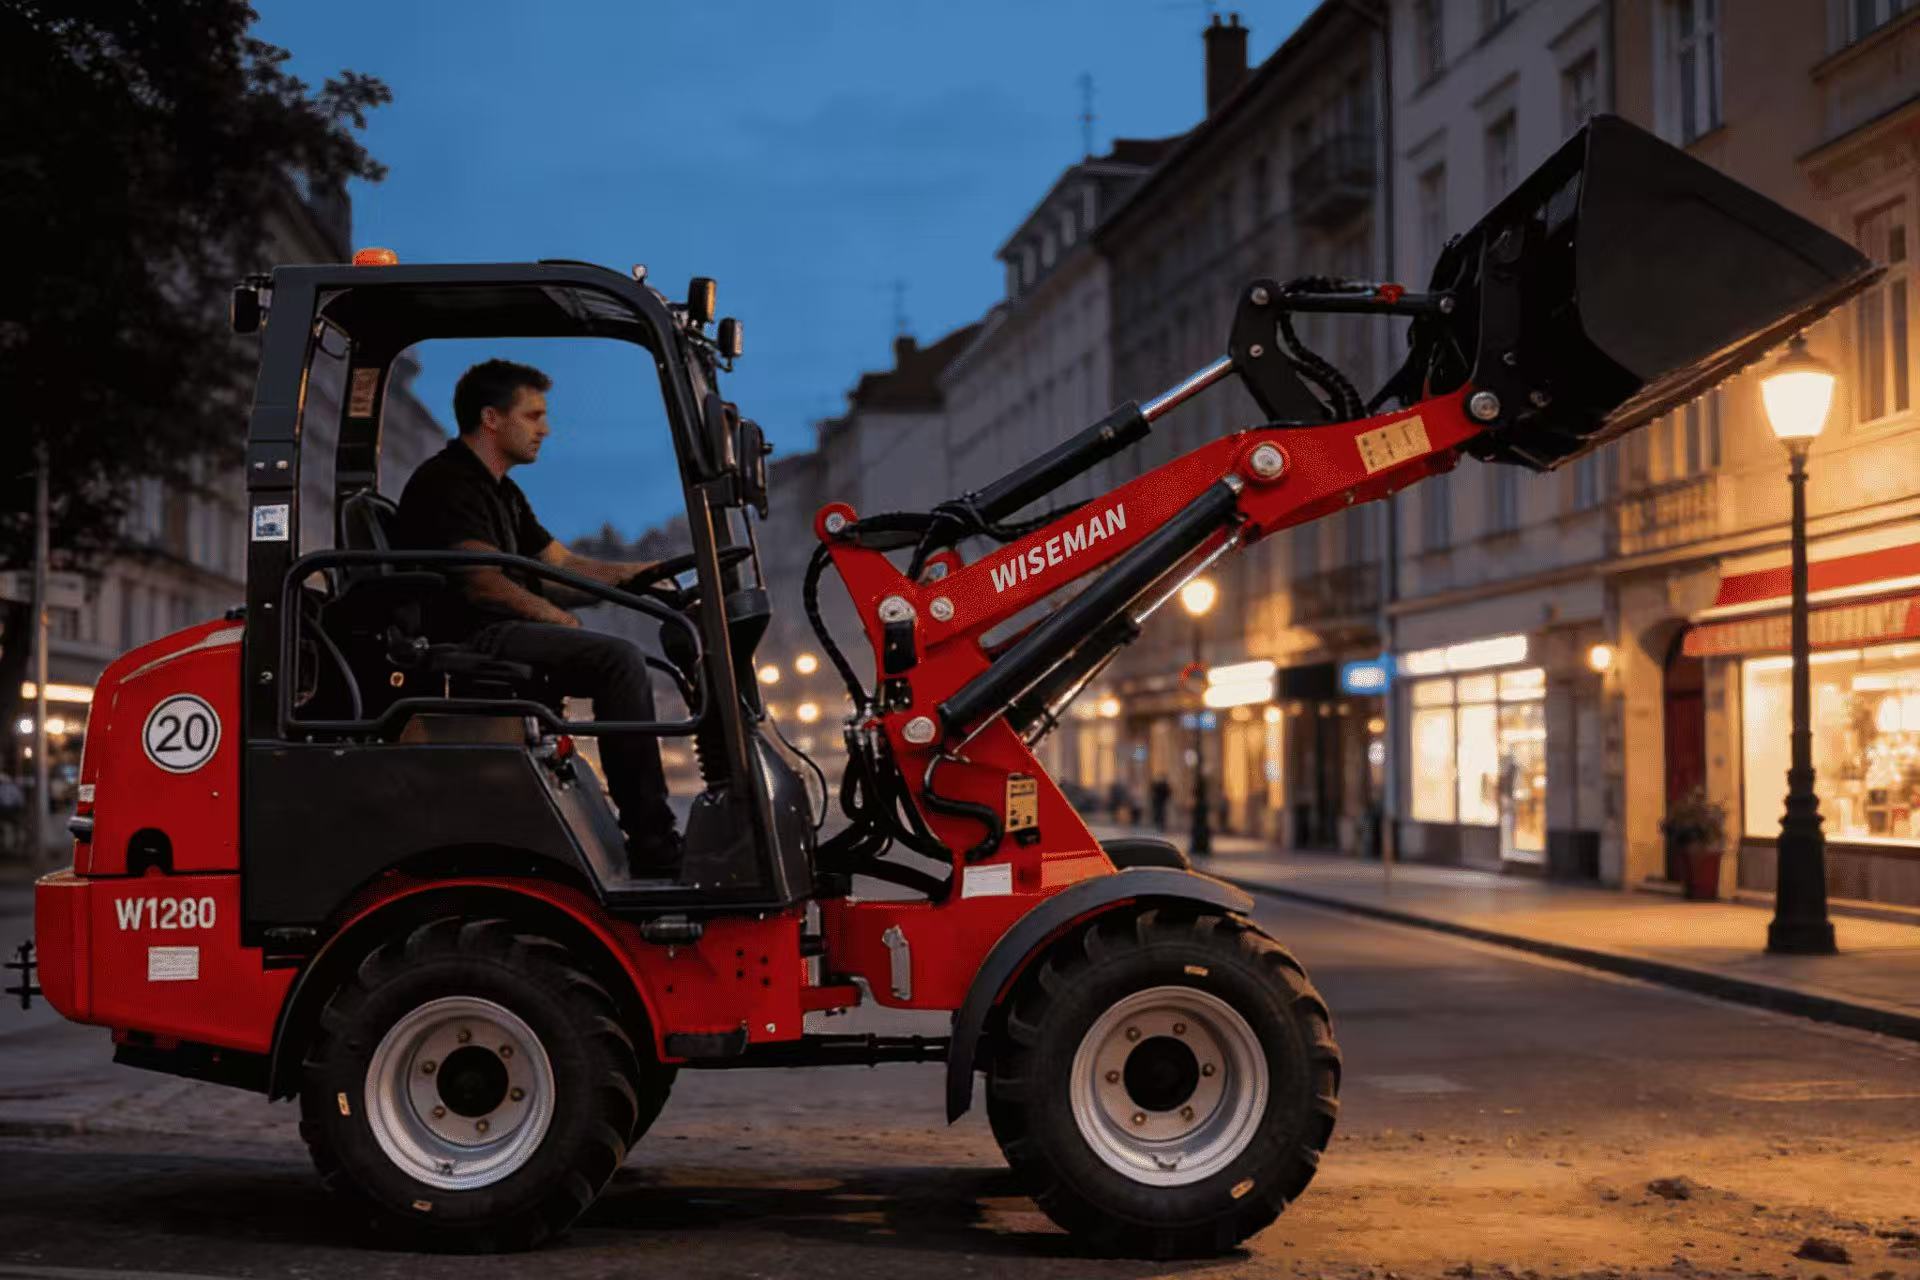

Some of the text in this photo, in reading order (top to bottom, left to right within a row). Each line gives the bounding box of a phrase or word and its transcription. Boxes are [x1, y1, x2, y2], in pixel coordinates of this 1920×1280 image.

[990, 503, 1127, 593] WISEMAN
[155, 713, 210, 752] 20
[115, 897, 216, 930] W1280
